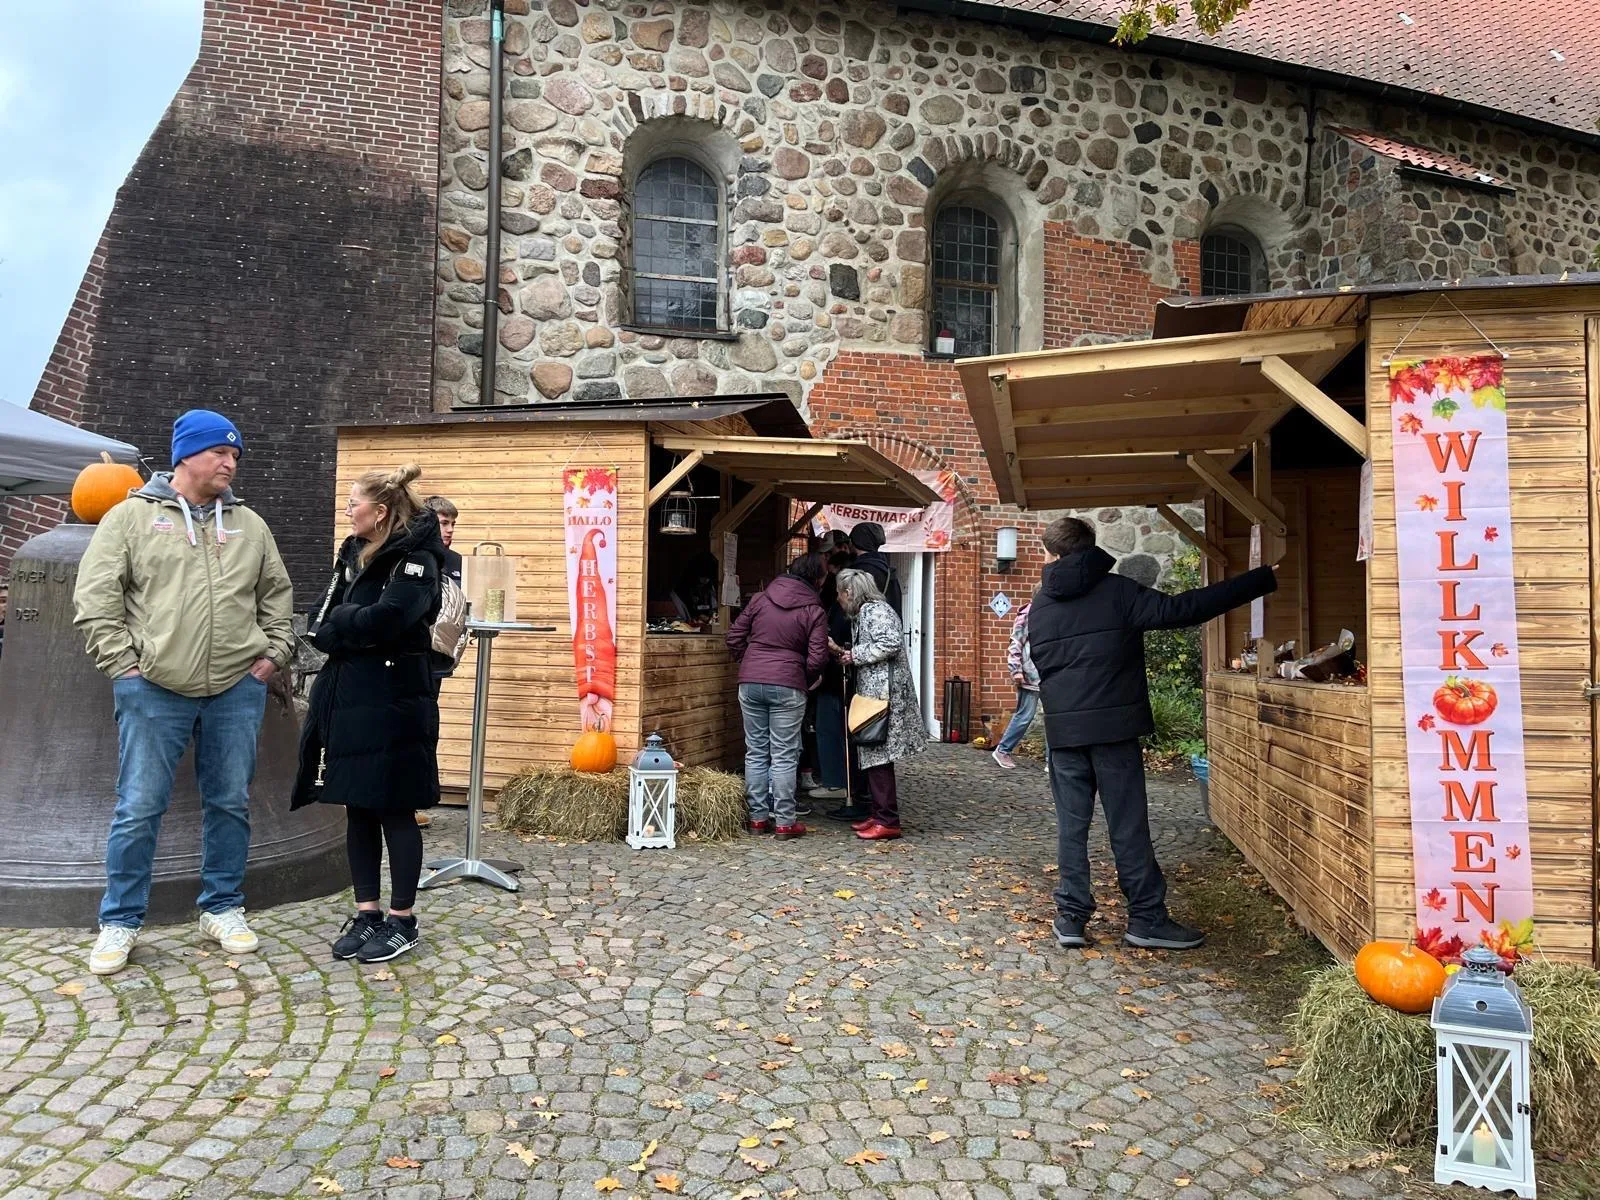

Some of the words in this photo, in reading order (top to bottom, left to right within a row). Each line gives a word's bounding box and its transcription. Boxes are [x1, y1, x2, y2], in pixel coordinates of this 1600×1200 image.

[567, 515, 612, 526] HALLO
[831, 504, 926, 523] HERBSTMARKT
[582, 559, 598, 683] HERBST
